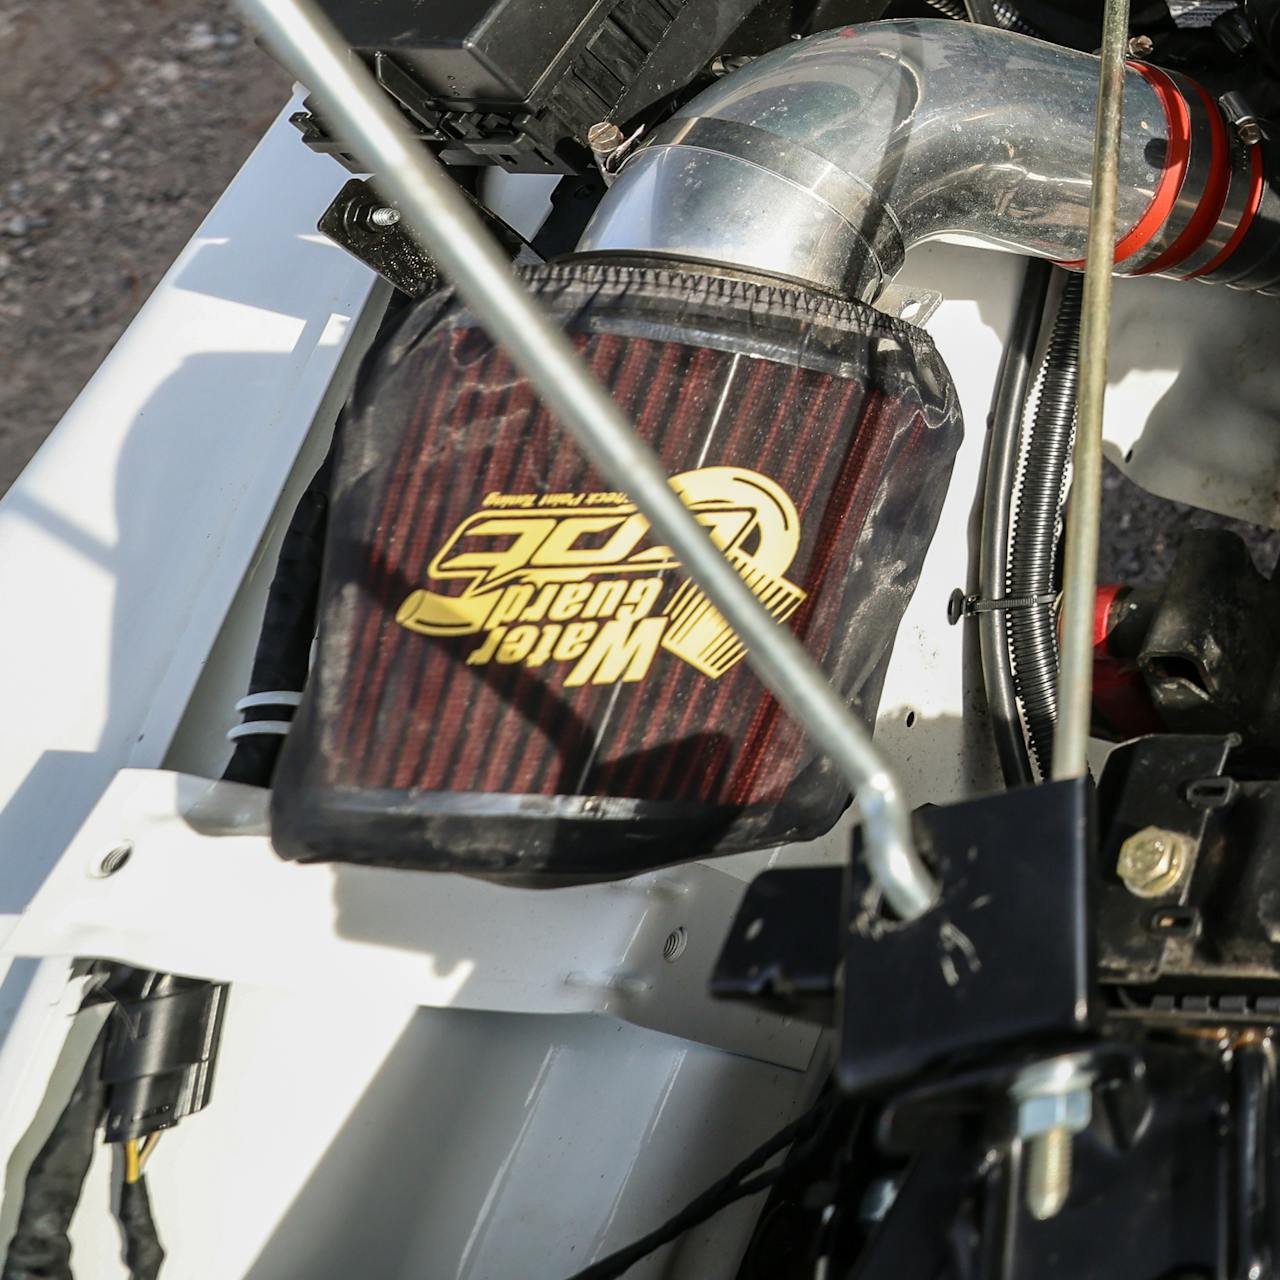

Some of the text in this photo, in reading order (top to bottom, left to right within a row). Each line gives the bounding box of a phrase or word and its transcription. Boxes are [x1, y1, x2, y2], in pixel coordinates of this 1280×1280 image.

[539, 494, 581, 508] Point
[484, 579, 665, 632] Guard
[466, 616, 671, 688] Water
